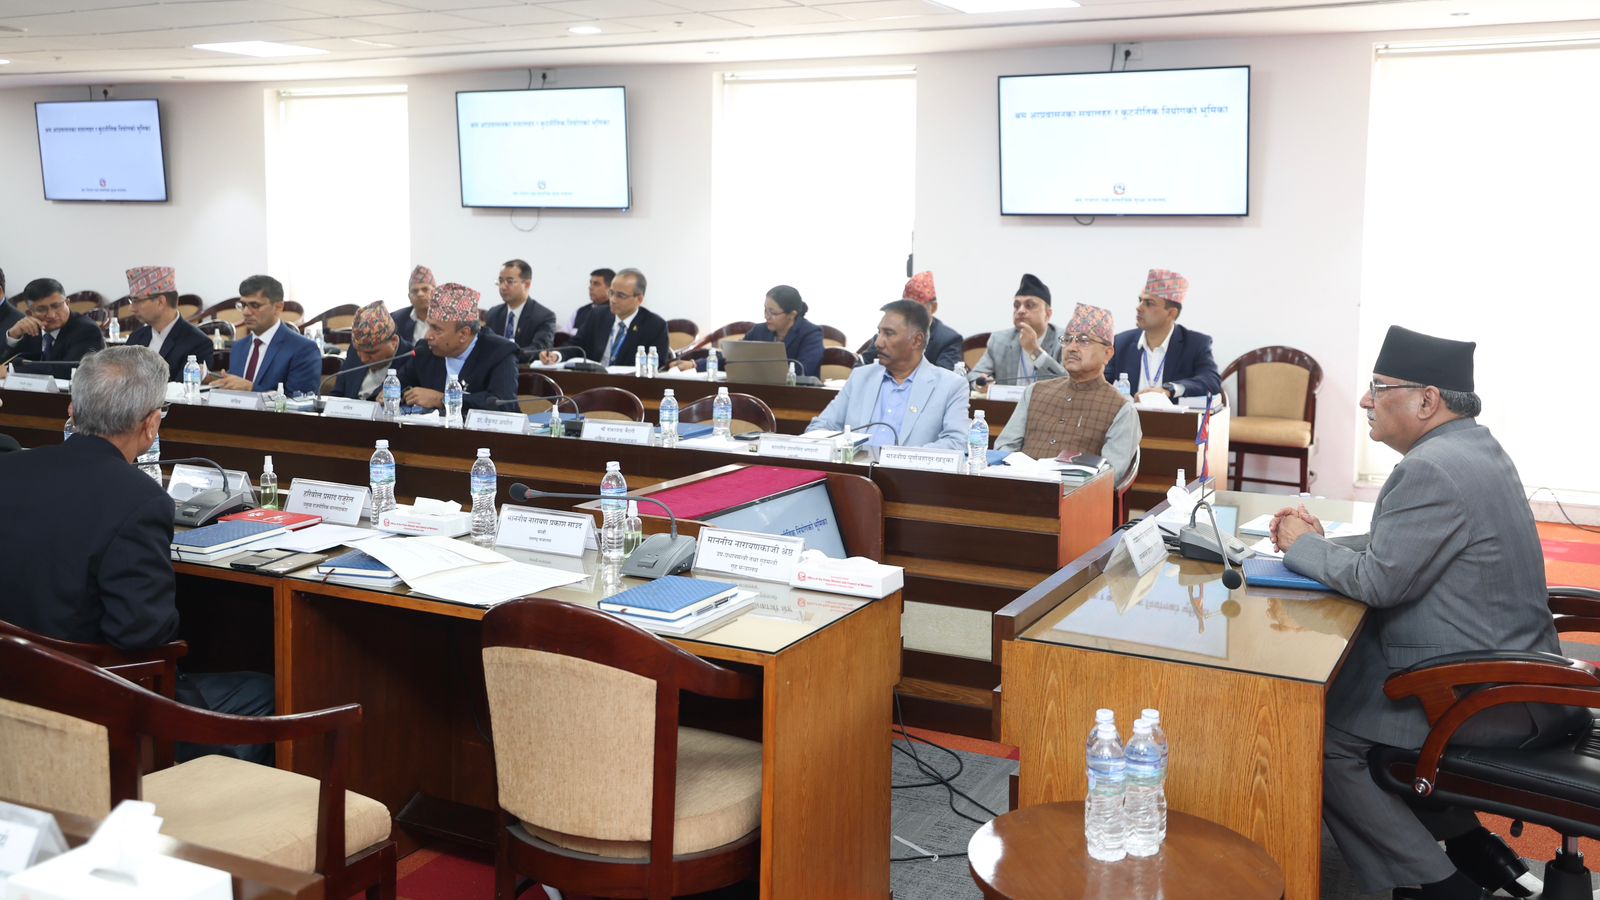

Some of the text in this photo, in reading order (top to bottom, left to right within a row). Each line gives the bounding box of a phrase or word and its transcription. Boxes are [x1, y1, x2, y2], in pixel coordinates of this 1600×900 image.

[886, 452, 907, 460] माननीय
[507, 513, 528, 523] माननीय
[528, 516, 549, 526] नारायण
[707, 535, 734, 547] माननीय
[734, 538, 780, 554] नारायणकाजी
